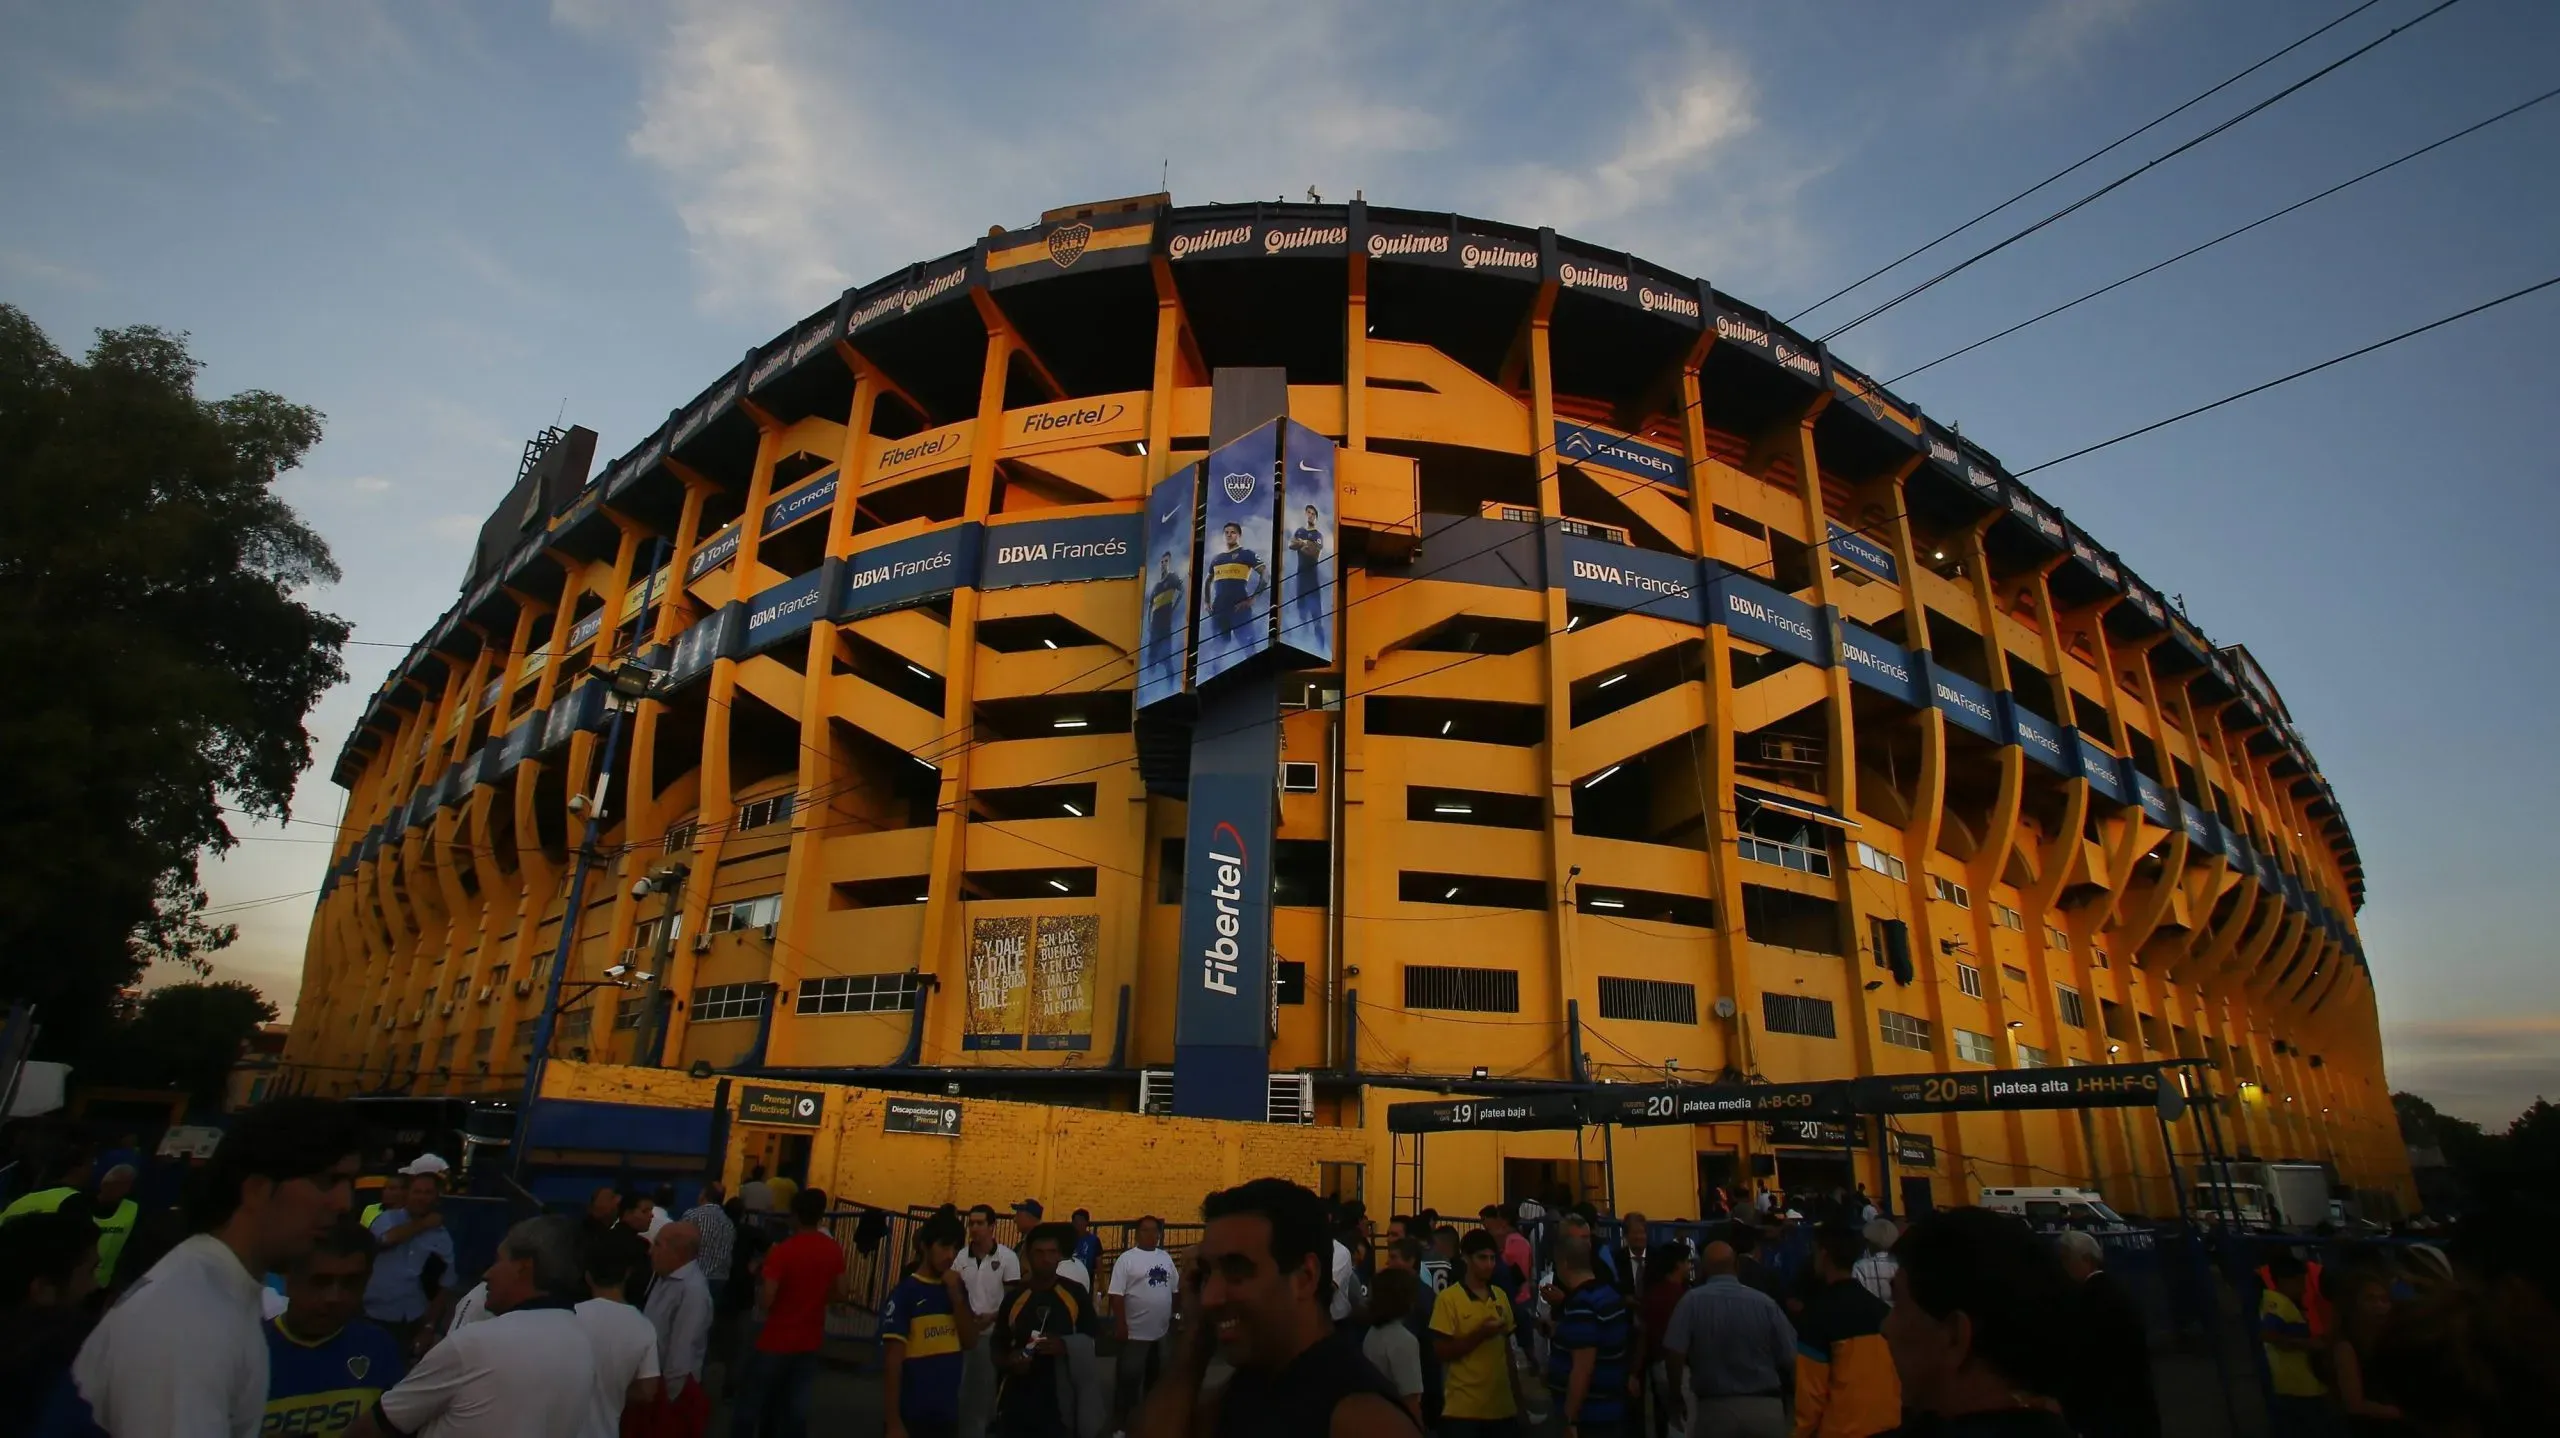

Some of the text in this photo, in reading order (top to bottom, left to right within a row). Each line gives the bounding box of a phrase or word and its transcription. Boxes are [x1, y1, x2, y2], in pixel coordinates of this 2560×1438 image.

[1169, 224, 1252, 260] Quilmes
[1264, 226, 1348, 256] Quilmes
[1367, 233, 1449, 259] Quilmes
[1461, 244, 1539, 269] Quilmes
[903, 265, 967, 314] Quilmes
[1559, 262, 1629, 292] Quilmes
[847, 287, 906, 336] Quilmes
[1639, 287, 1699, 318] Quilmes
[1716, 315, 1768, 348] Quilmes
[1775, 344, 1820, 377] Quilmes
[1023, 404, 1106, 433] Fibertel
[879, 434, 945, 470] Fibertel
[1597, 443, 1673, 474] CITROËN
[998, 537, 1127, 565] BBVA Francés
[1843, 539, 1889, 571] CITROËN
[852, 552, 952, 590] BBVA Francés
[1572, 560, 1690, 599] BBVA Francés
[749, 589, 820, 630] BBVA Francés
[1729, 594, 1813, 642] BBVA Francés
[1842, 642, 1909, 683] BBVA Francés
[1936, 683, 1992, 721] BBVA Francés
[1043, 930, 1075, 946] EN LAS
[1204, 851, 1242, 996] Fibertel
[983, 936, 1025, 957] Y DALE
[1041, 943, 1078, 961] BUENAS
[974, 953, 1023, 979] Y DALE
[1041, 956, 1083, 974] Y EN LAS
[1048, 971, 1079, 986] MALAS
[969, 973, 1026, 993] Y DALE BOCA
[1042, 985, 1083, 1002] TE VOY A
[763, 1094, 792, 1105] Prensa
[1924, 1078, 1958, 1103] 20
[1959, 1085, 1978, 1095] BIS
[1993, 1082, 2037, 1097] platea
[2041, 1080, 2069, 1093] alta
[2075, 1075, 2158, 1093] J-H-I-F-G
[750, 1104, 790, 1115] Directivos
[891, 1105, 939, 1116] Discapacitados
[1452, 1104, 1472, 1122] 19
[1480, 1109, 1505, 1120] platea
[1507, 1107, 1526, 1118] baja
[1529, 1106, 1536, 1116] L
[1647, 1096, 1674, 1116] 20
[1683, 1101, 1715, 1113] platea
[1718, 1098, 1751, 1110] media
[1758, 1094, 1812, 1109] A-B-C-D
[1800, 1121, 1818, 1139] 20
[260, 1399, 361, 1438] PEPSI
